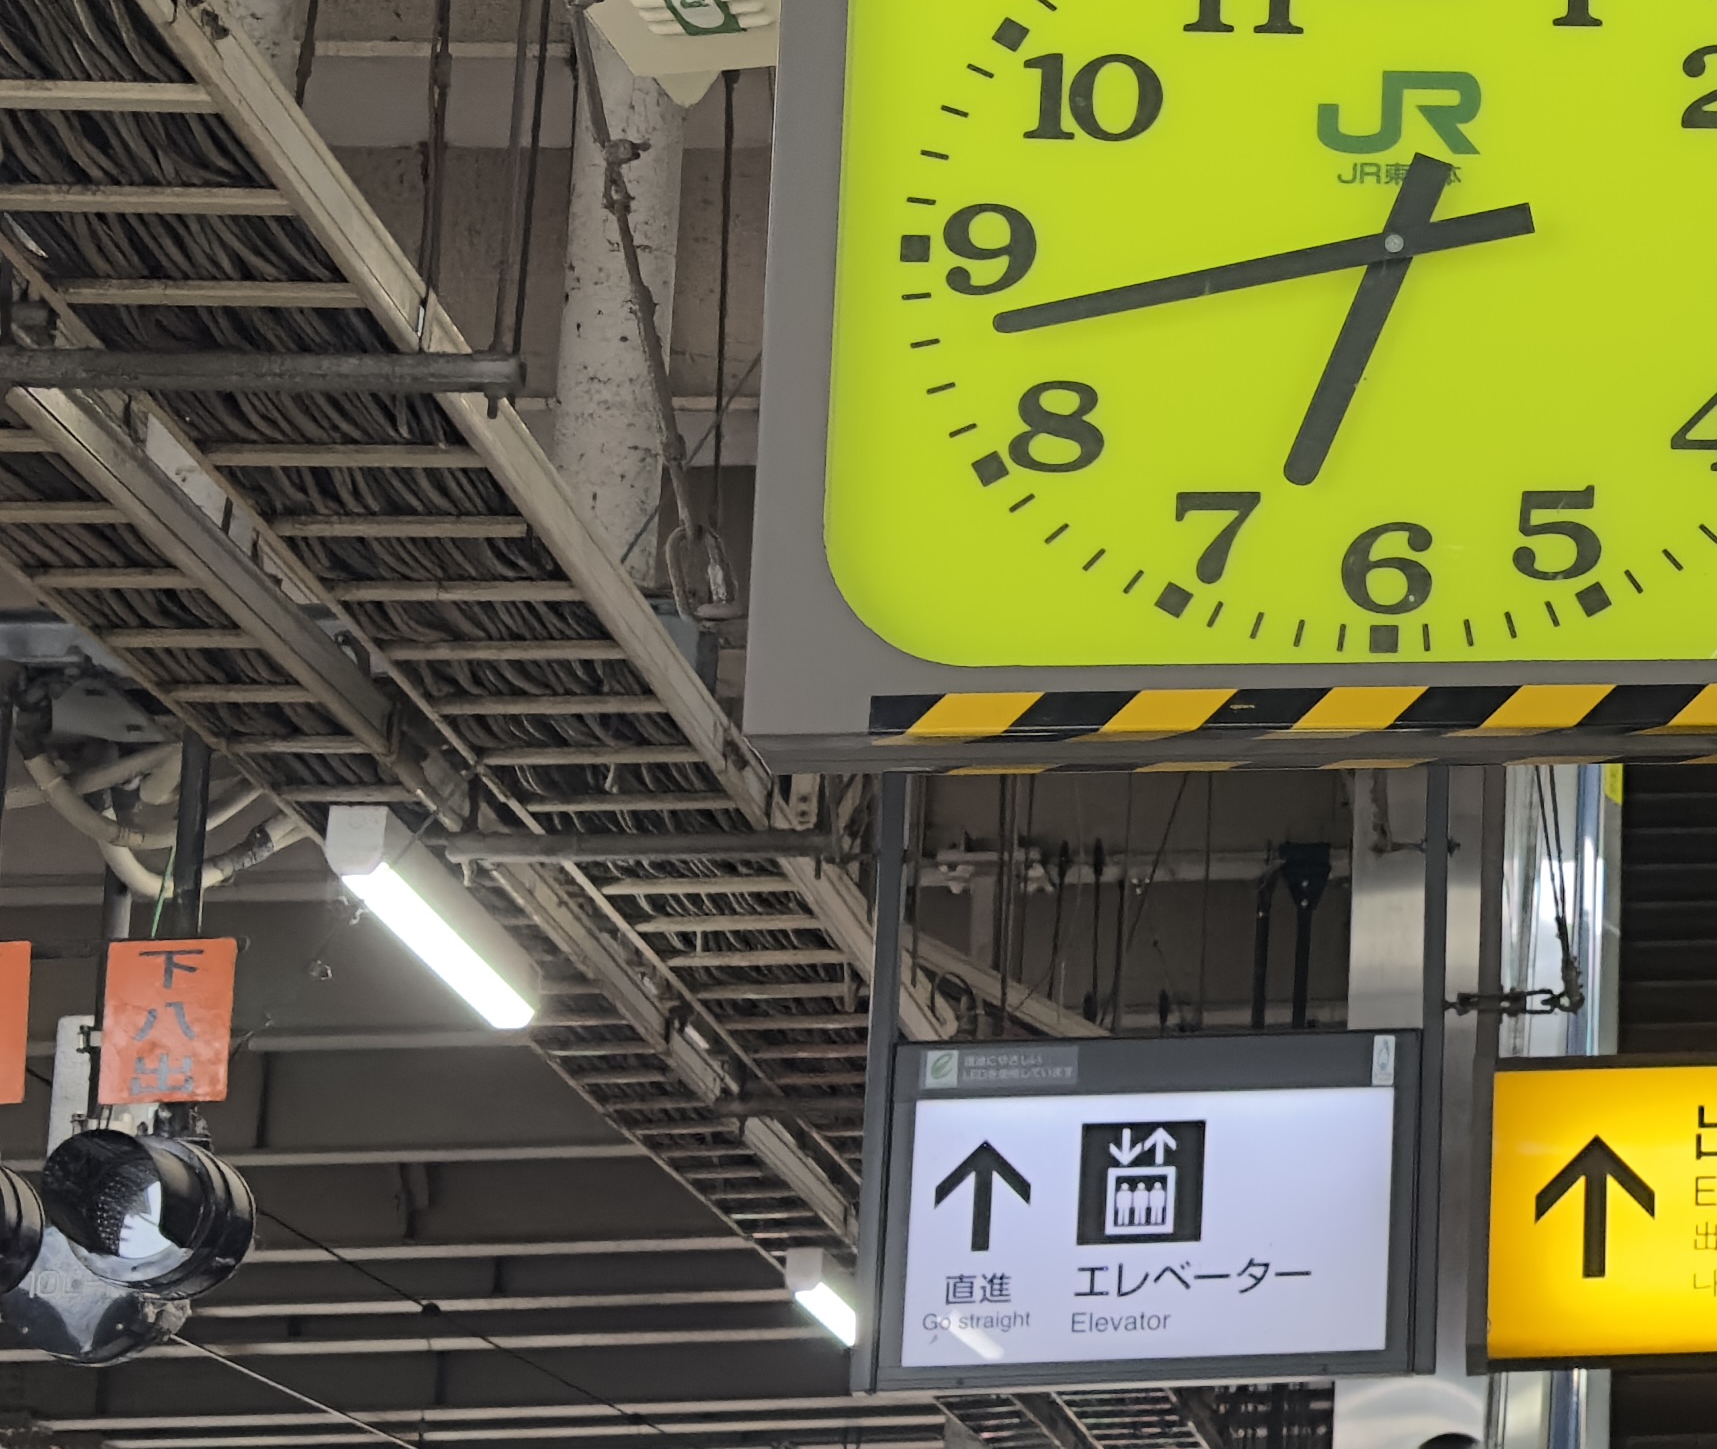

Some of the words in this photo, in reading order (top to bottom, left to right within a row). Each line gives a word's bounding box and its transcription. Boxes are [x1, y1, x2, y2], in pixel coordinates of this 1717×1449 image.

[1021, 51, 1164, 142] 10
[1315, 69, 1482, 157] JR
[941, 201, 1038, 297] 9
[1007, 378, 1105, 474] 8
[1173, 489, 1262, 585] 7
[1339, 520, 1433, 615] 6
[1511, 484, 1602, 580] 5
[922, 1313, 952, 1331] Go
[958, 1310, 1032, 1333] straight
[944, 1271, 1013, 1306] 直進
[1070, 1310, 1172, 1334] Elevator
[1073, 1257, 1313, 1297] エレベーター
